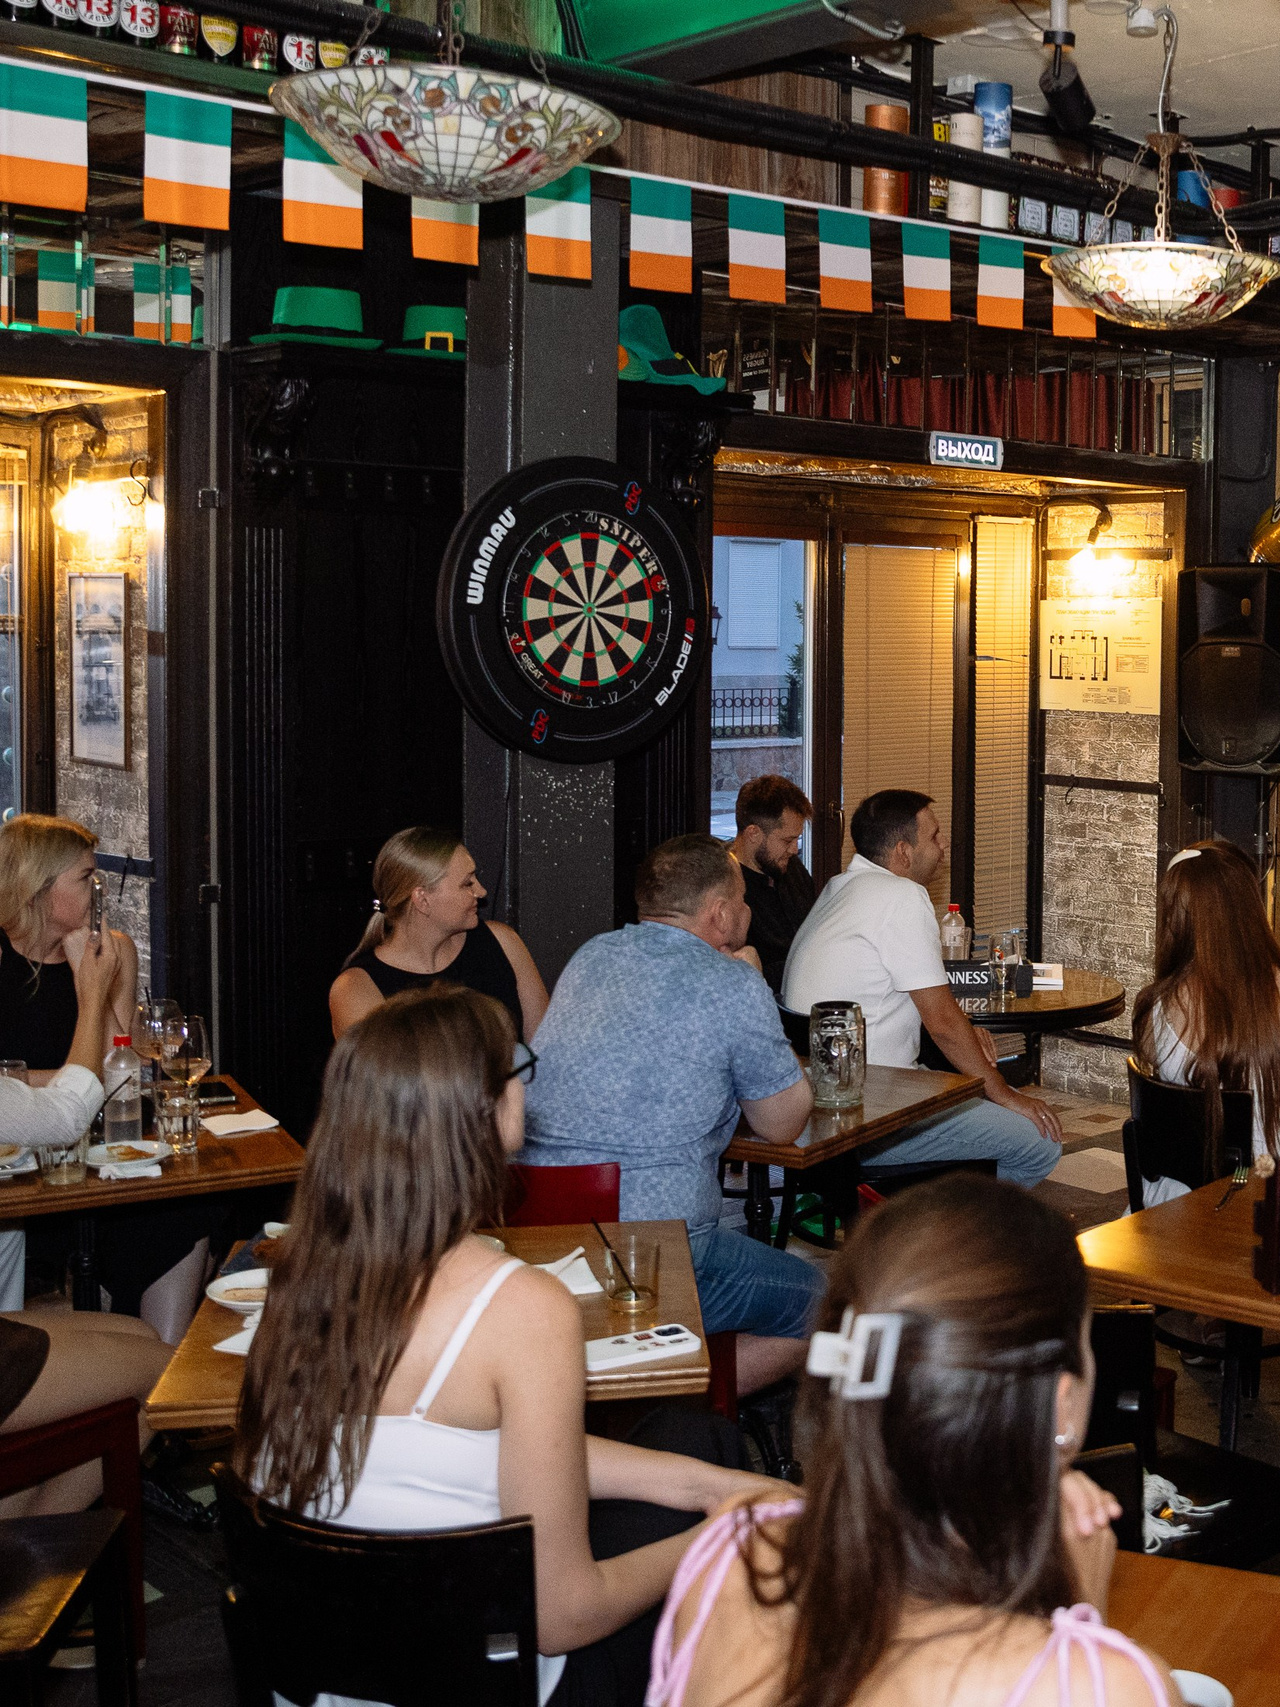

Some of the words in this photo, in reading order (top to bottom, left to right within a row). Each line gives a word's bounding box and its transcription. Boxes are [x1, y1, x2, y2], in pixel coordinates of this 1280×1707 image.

[130, 4, 156, 28] 13
[294, 41, 315, 62] 13
[937, 439, 995, 463] ВЫХОД
[625, 484, 642, 512] PDC
[598, 518, 658, 576] SNIPER
[520, 652, 545, 680] GREAT
